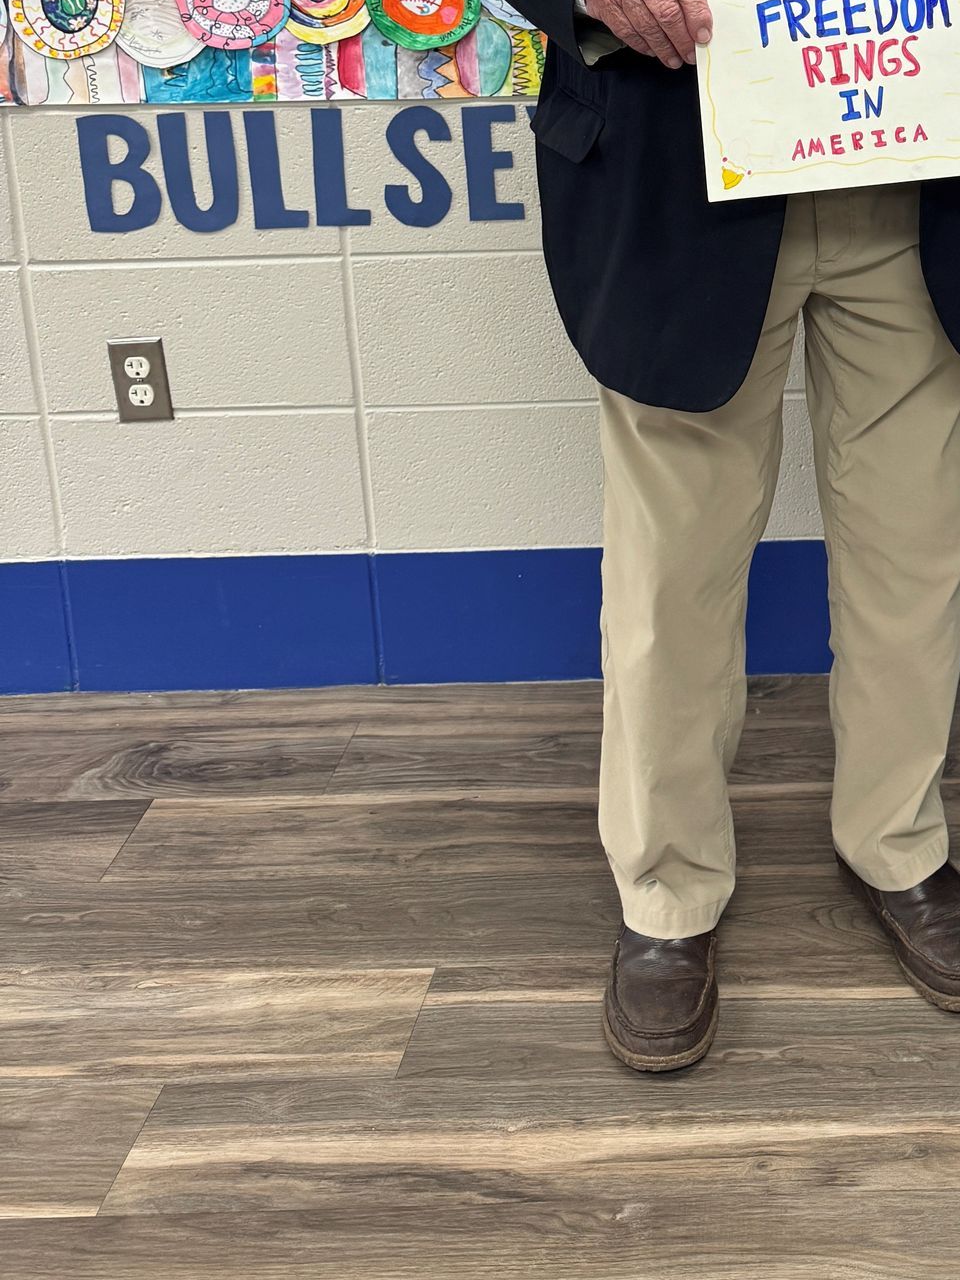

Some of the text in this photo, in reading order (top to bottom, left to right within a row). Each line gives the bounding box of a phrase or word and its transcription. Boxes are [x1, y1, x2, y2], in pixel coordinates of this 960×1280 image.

[801, 35, 921, 88] RINGS
[839, 86, 884, 122] IN
[791, 124, 929, 161] AMERICA
[76, 104, 537, 234] BULLSE
